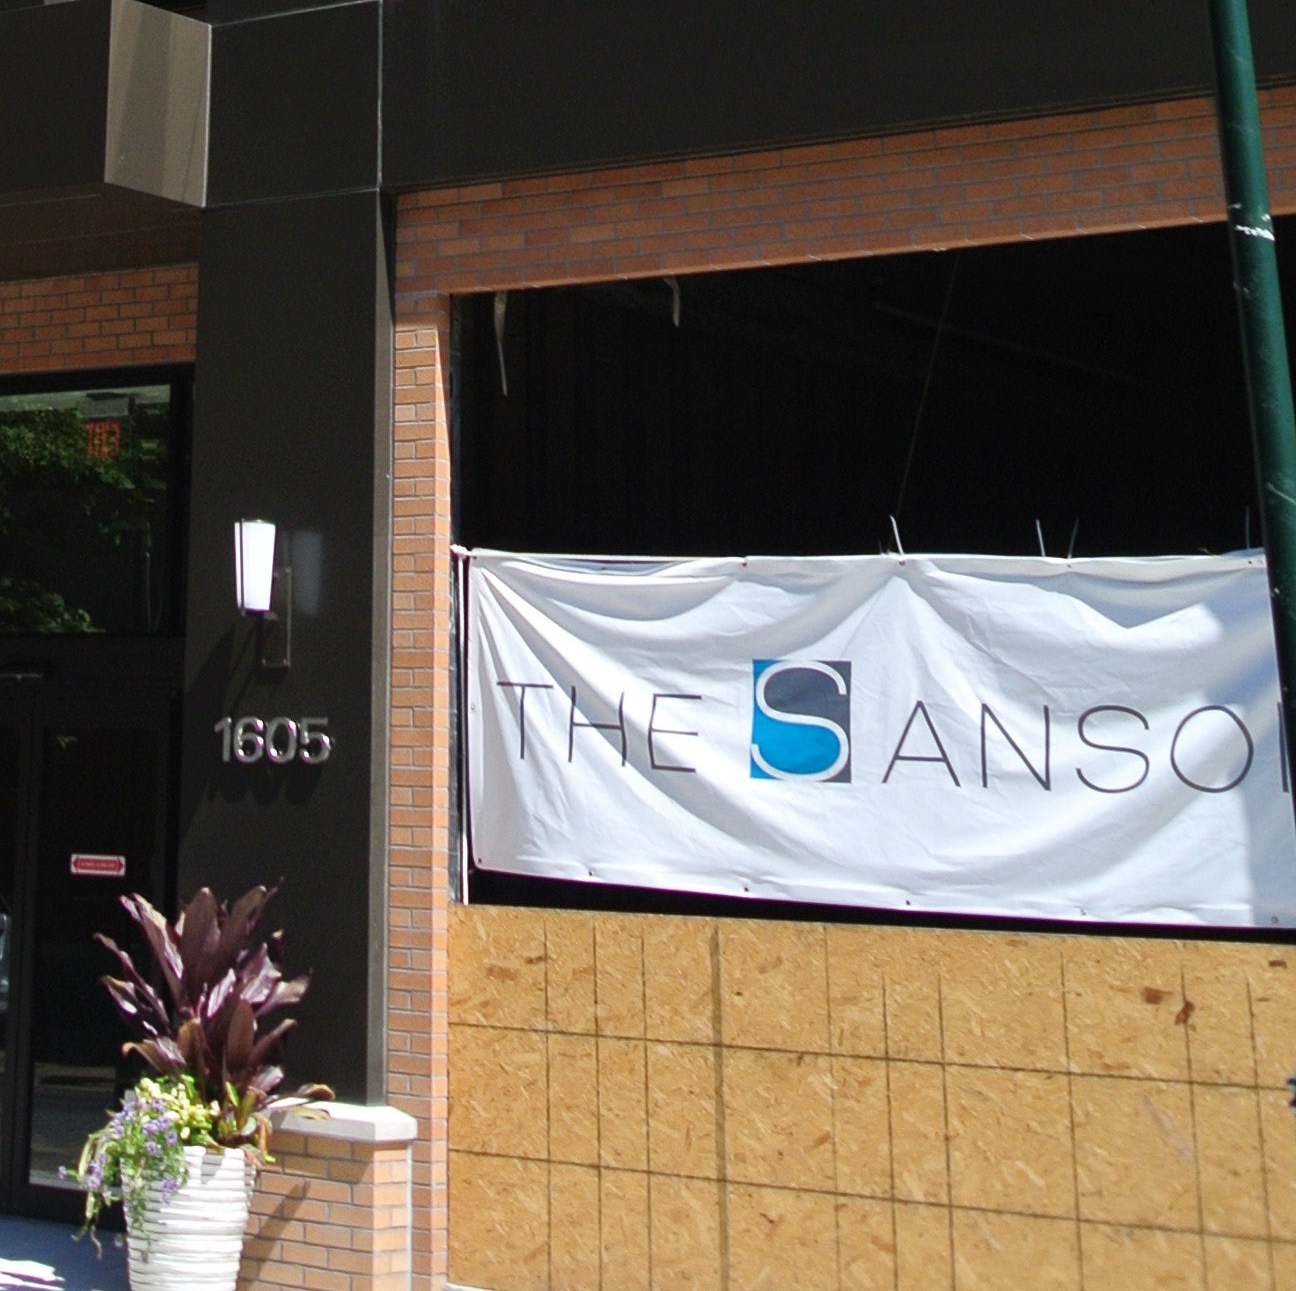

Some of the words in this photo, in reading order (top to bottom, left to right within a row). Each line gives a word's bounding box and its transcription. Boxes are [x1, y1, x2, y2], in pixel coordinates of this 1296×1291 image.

[213, 715, 333, 765] 1605
[495, 679, 704, 774] THE
[750, 659, 1291, 795] SANSO
